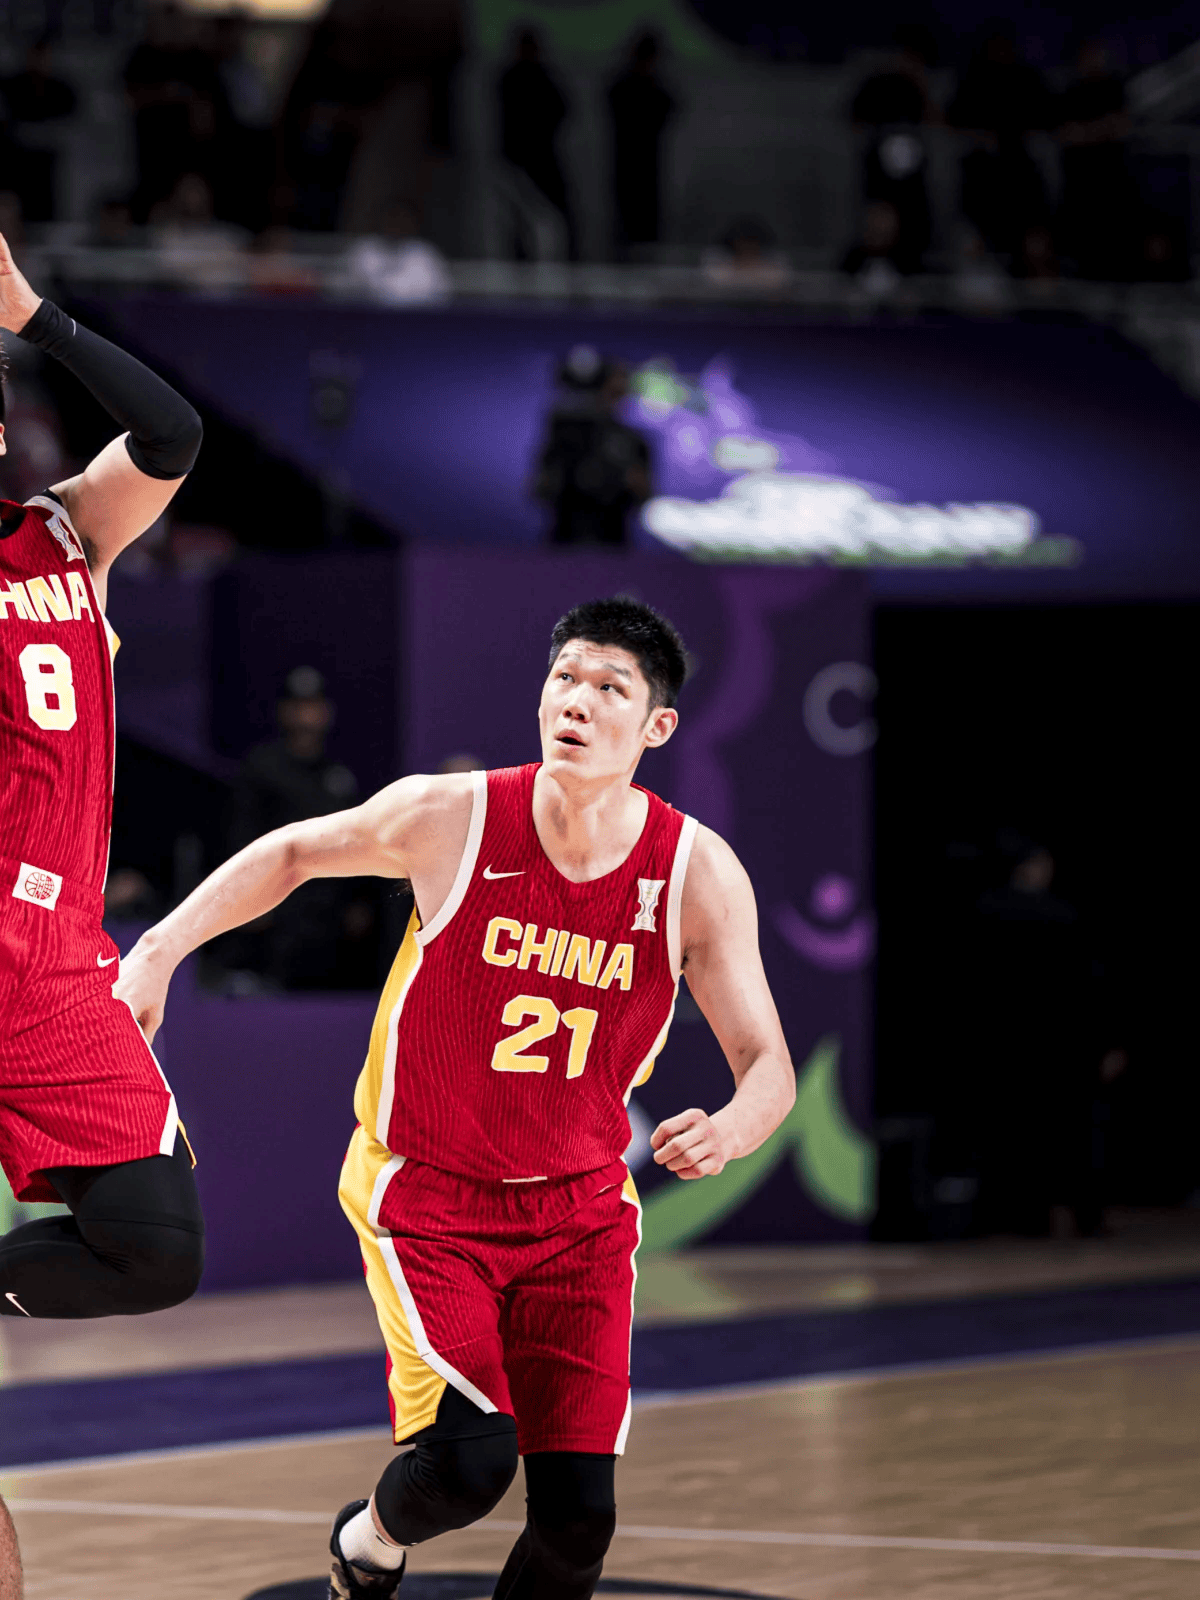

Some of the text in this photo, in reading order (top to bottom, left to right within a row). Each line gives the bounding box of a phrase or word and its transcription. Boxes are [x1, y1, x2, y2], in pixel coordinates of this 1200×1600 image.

[18, 643, 78, 731] 8
[482, 915, 635, 991] CHINA
[491, 994, 599, 1080] 21
